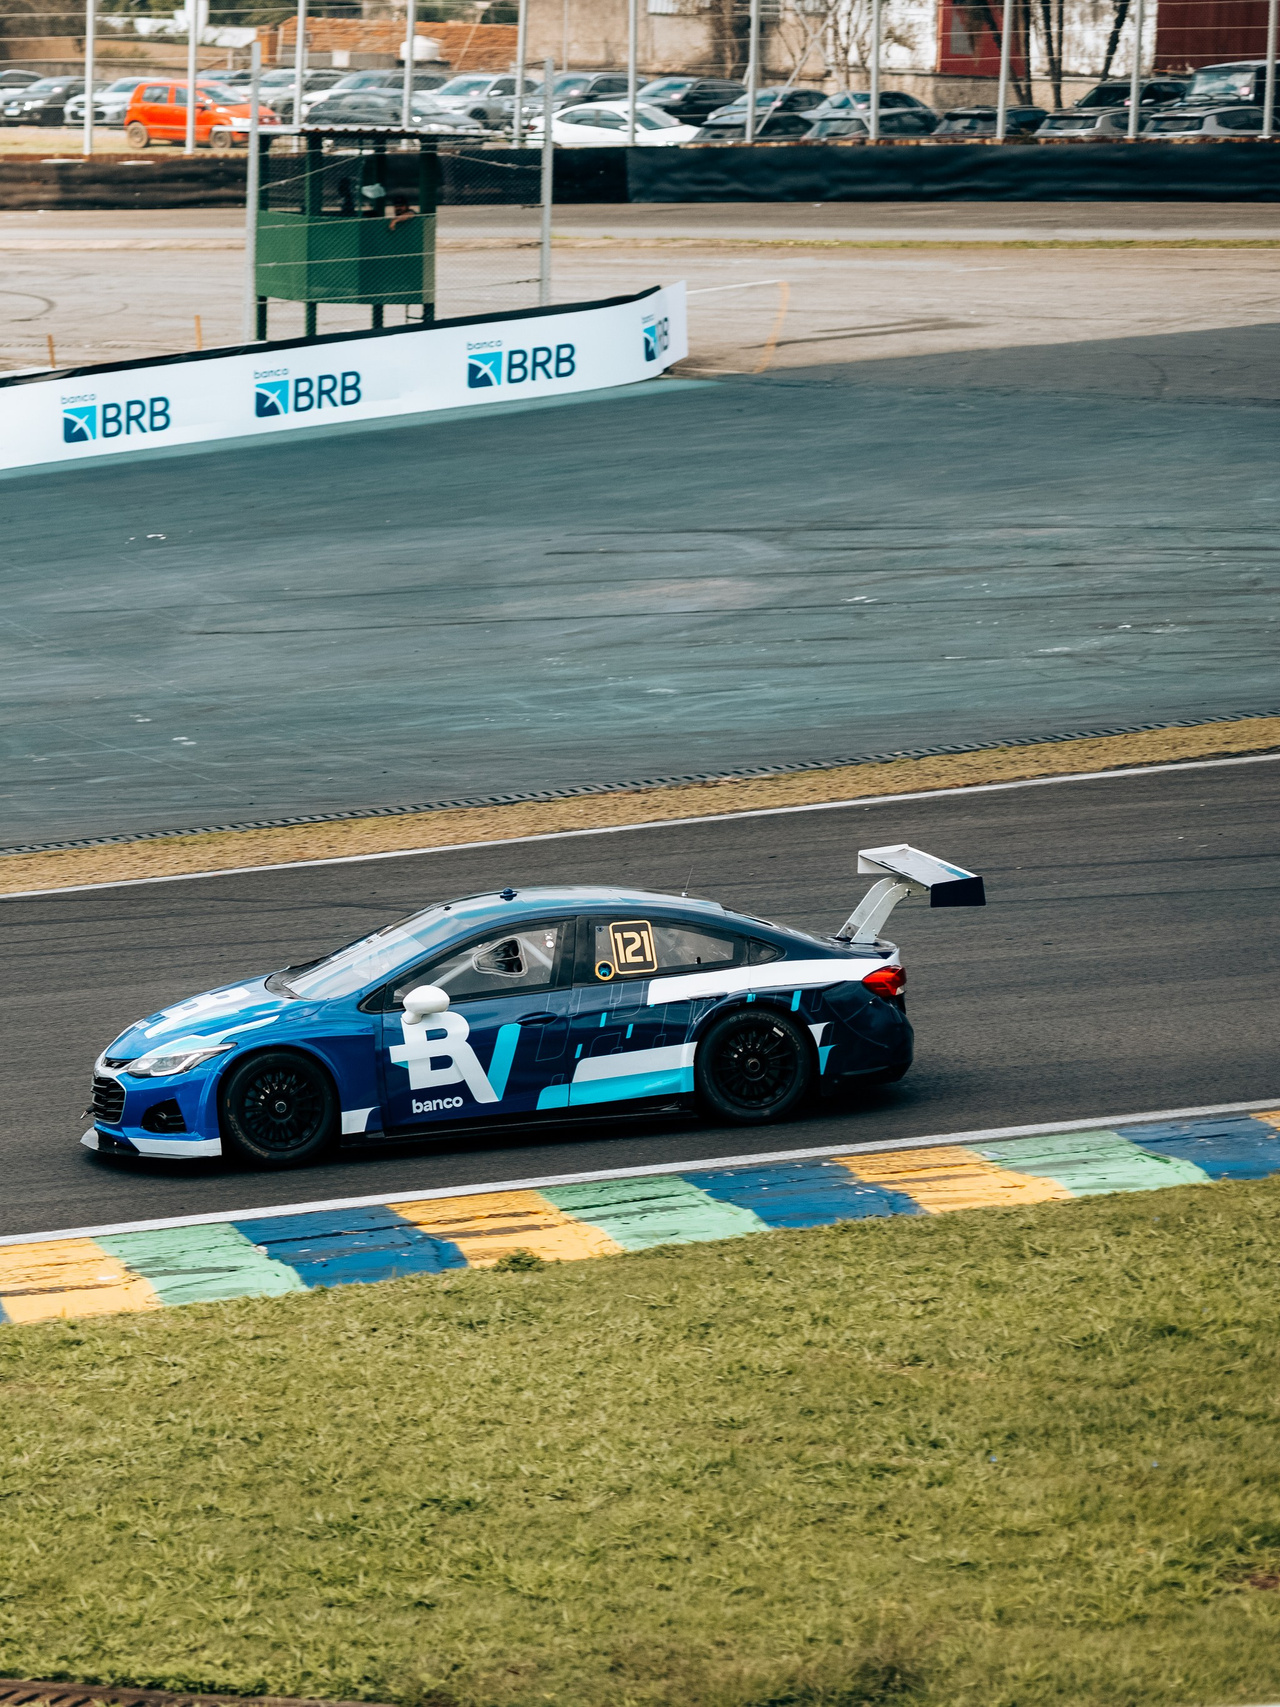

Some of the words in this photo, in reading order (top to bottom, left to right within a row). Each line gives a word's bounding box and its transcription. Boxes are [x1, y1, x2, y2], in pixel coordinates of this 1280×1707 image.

[466, 339, 503, 351] banco
[254, 368, 290, 380] banco
[507, 343, 576, 384] BRB
[61, 393, 97, 405] banco
[293, 370, 362, 412] BRB
[101, 396, 171, 438] BRB
[613, 930, 653, 964] 121
[411, 1096, 464, 1114] banco
